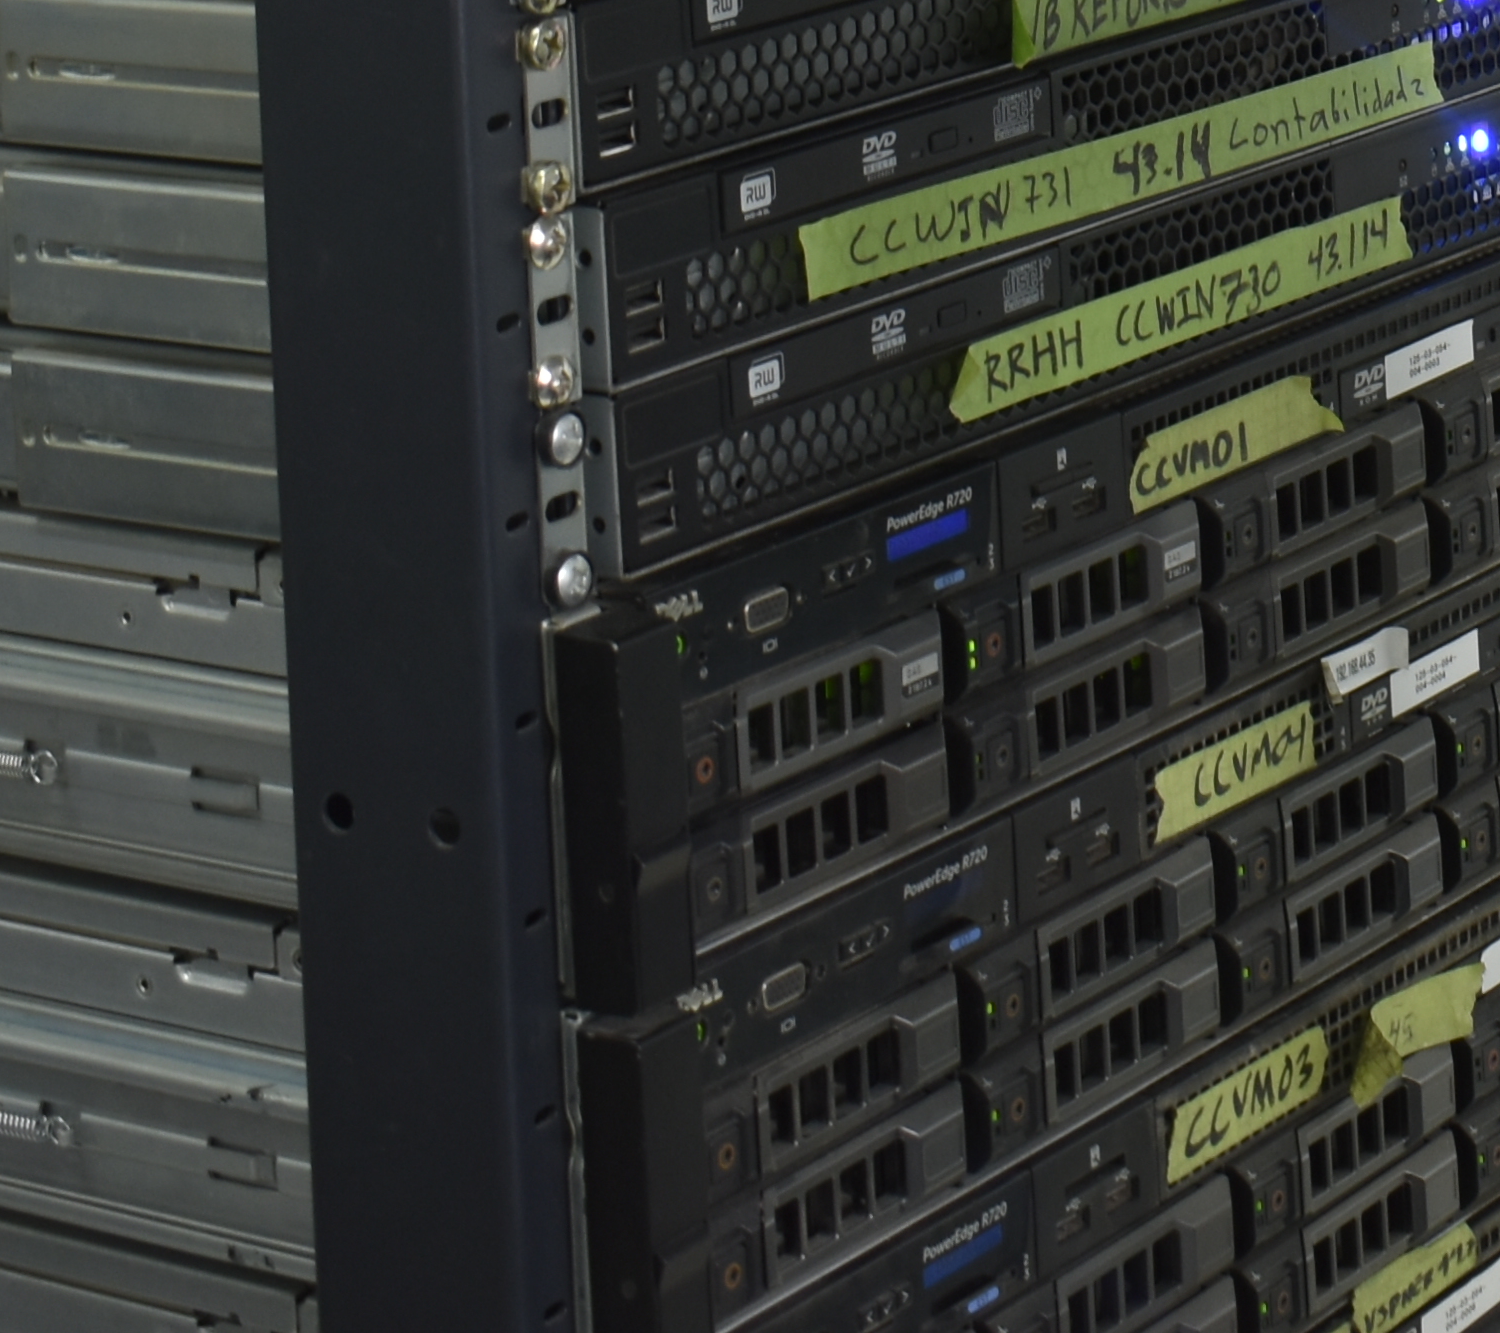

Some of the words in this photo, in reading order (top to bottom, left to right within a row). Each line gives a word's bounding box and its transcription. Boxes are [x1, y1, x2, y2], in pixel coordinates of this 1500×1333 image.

[1230, 66, 1408, 151] Contabilidad
[862, 130, 897, 155] DVD
[746, 182, 767, 202] RW
[872, 308, 906, 334] DVD
[754, 367, 775, 390] RW
[984, 319, 1086, 404] RRHH
[1354, 363, 1385, 390] DVD
[1135, 421, 1248, 496] CCVM01
[886, 501, 944, 534] PowerEdge
[946, 486, 973, 512] R720
[1361, 687, 1387, 712] DVD
[903, 861, 960, 901] PowerEdge
[961, 844, 988, 872] R720
[1184, 1043, 1314, 1159] CCVM03
[922, 1220, 980, 1264] PowerEdge
[981, 1201, 1008, 1229] R720
